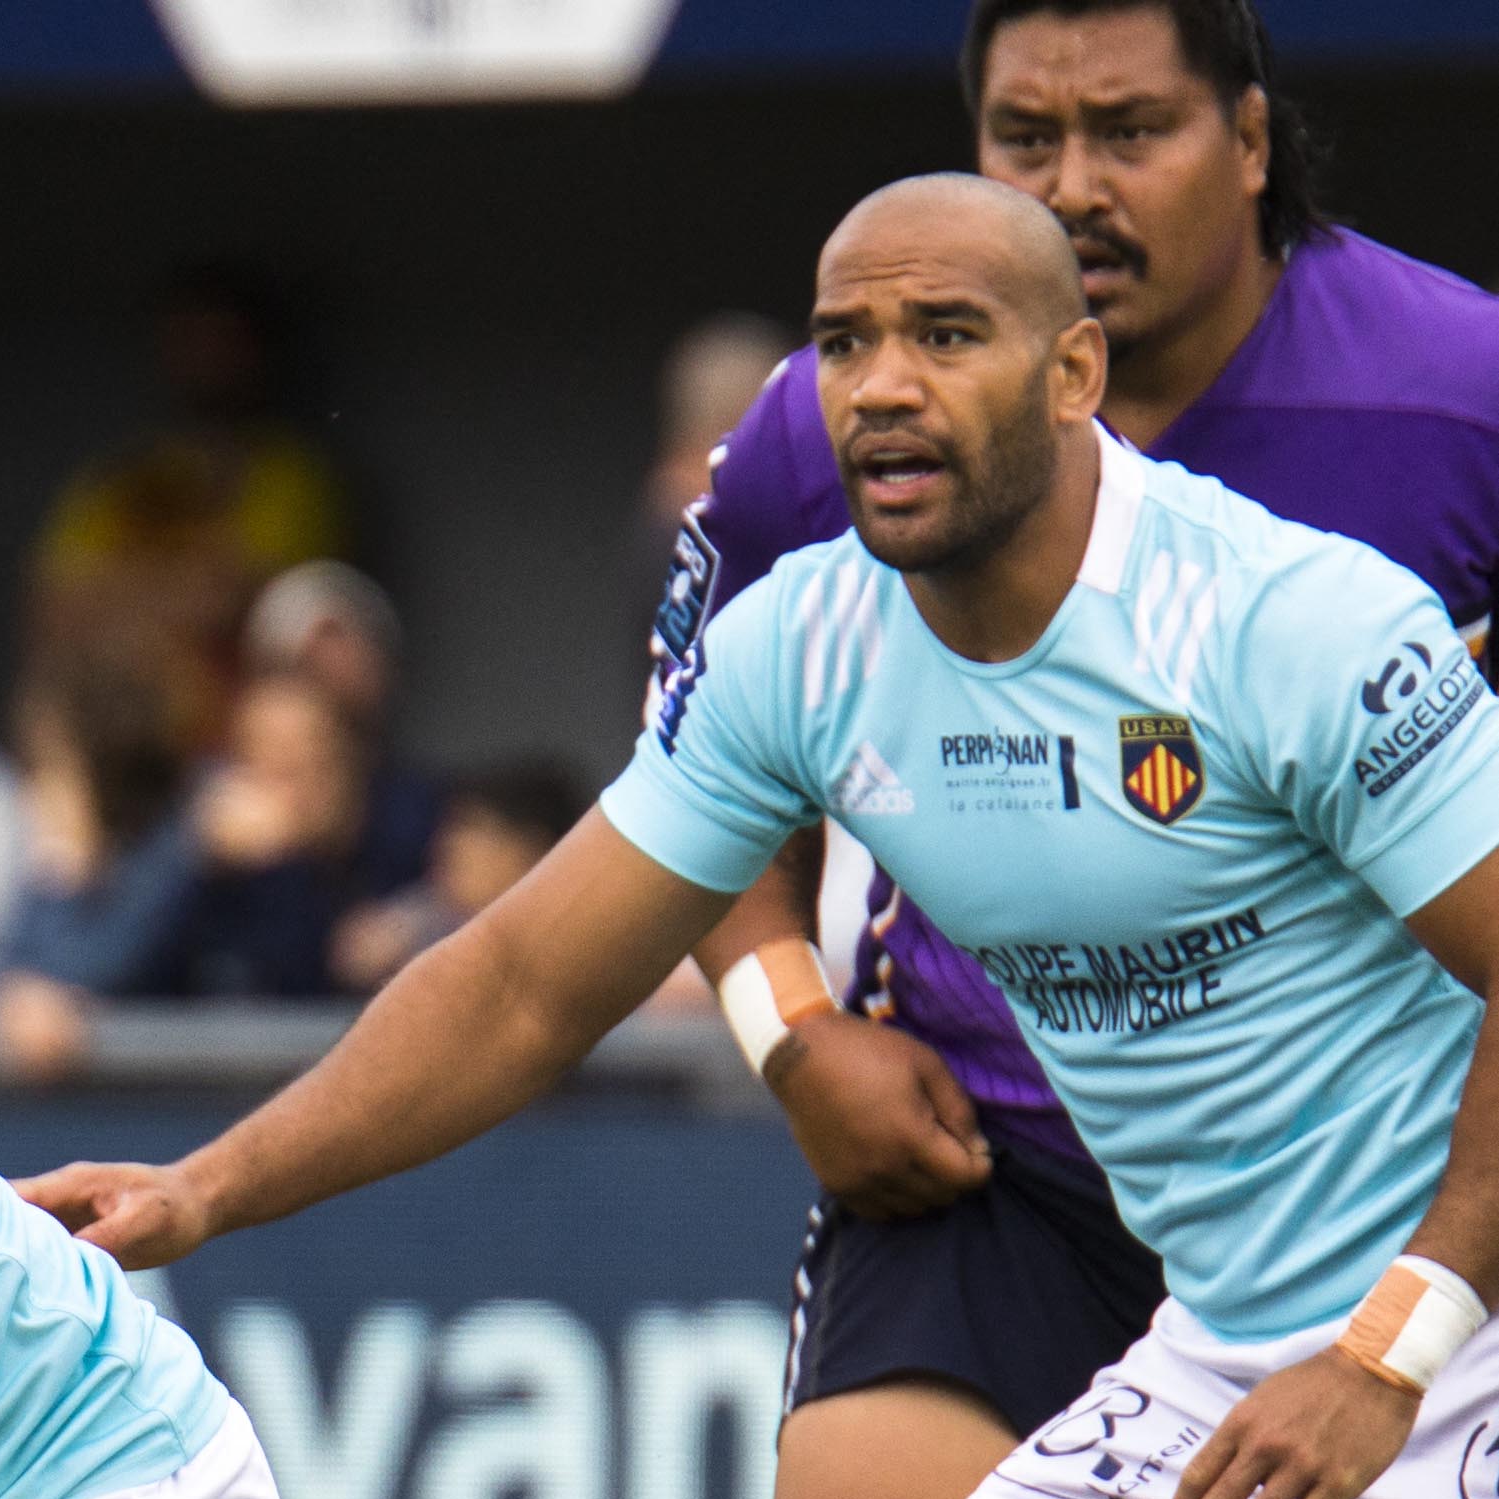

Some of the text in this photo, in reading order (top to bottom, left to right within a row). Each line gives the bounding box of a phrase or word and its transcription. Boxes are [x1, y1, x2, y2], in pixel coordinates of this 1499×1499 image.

[1123, 720, 1186, 735] USAP
[1081, 908, 1266, 982] MAURIN
[1025, 965, 1221, 1033] AUTOMOBILE
